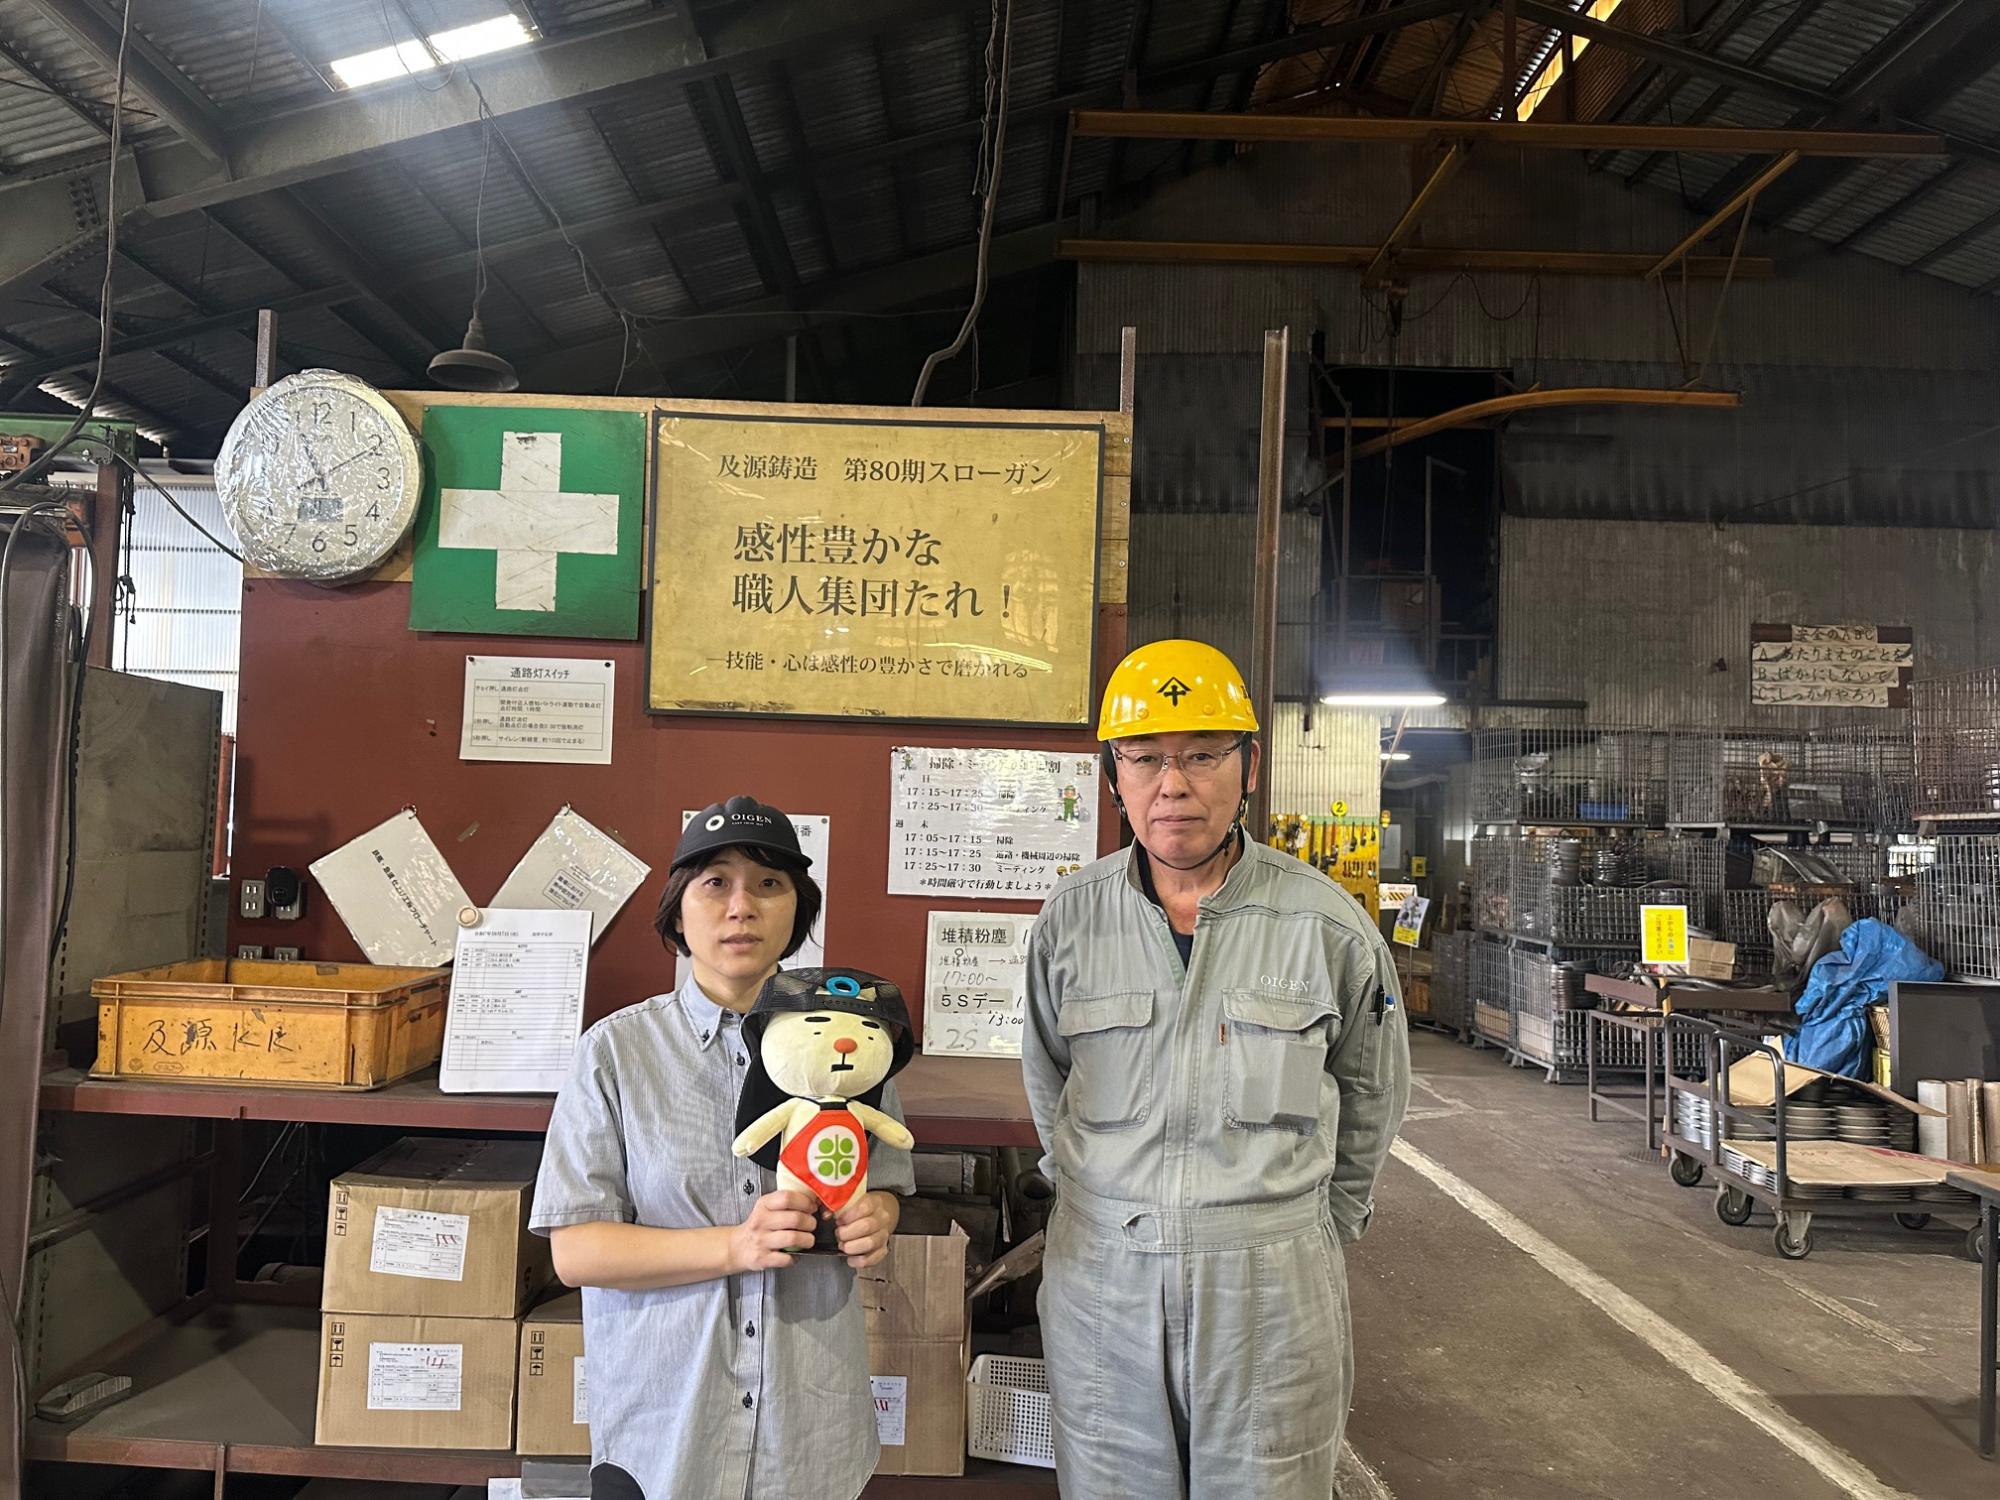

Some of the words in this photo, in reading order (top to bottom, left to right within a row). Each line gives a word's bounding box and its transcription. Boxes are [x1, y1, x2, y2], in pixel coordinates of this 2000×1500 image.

[311, 402, 332, 425] 12
[367, 433, 383, 456] 2
[377, 466, 391, 490] 3
[717, 453, 818, 481] 及源鋳造
[844, 456, 1053, 486] 第80期スローガン
[364, 501, 381, 522] 4
[311, 531, 327, 553] 6
[343, 524, 358, 547] 5
[732, 522, 942, 567] 感性豊かな
[731, 573, 1012, 619] 職人集団たれ！
[1335, 801, 1344, 812] 2
[731, 813, 773, 825] OIGEN
[941, 926, 1008, 944] 堆積粉塵
[1260, 974, 1310, 993] OIGEN
[941, 992, 1005, 1008] 5Sデー
